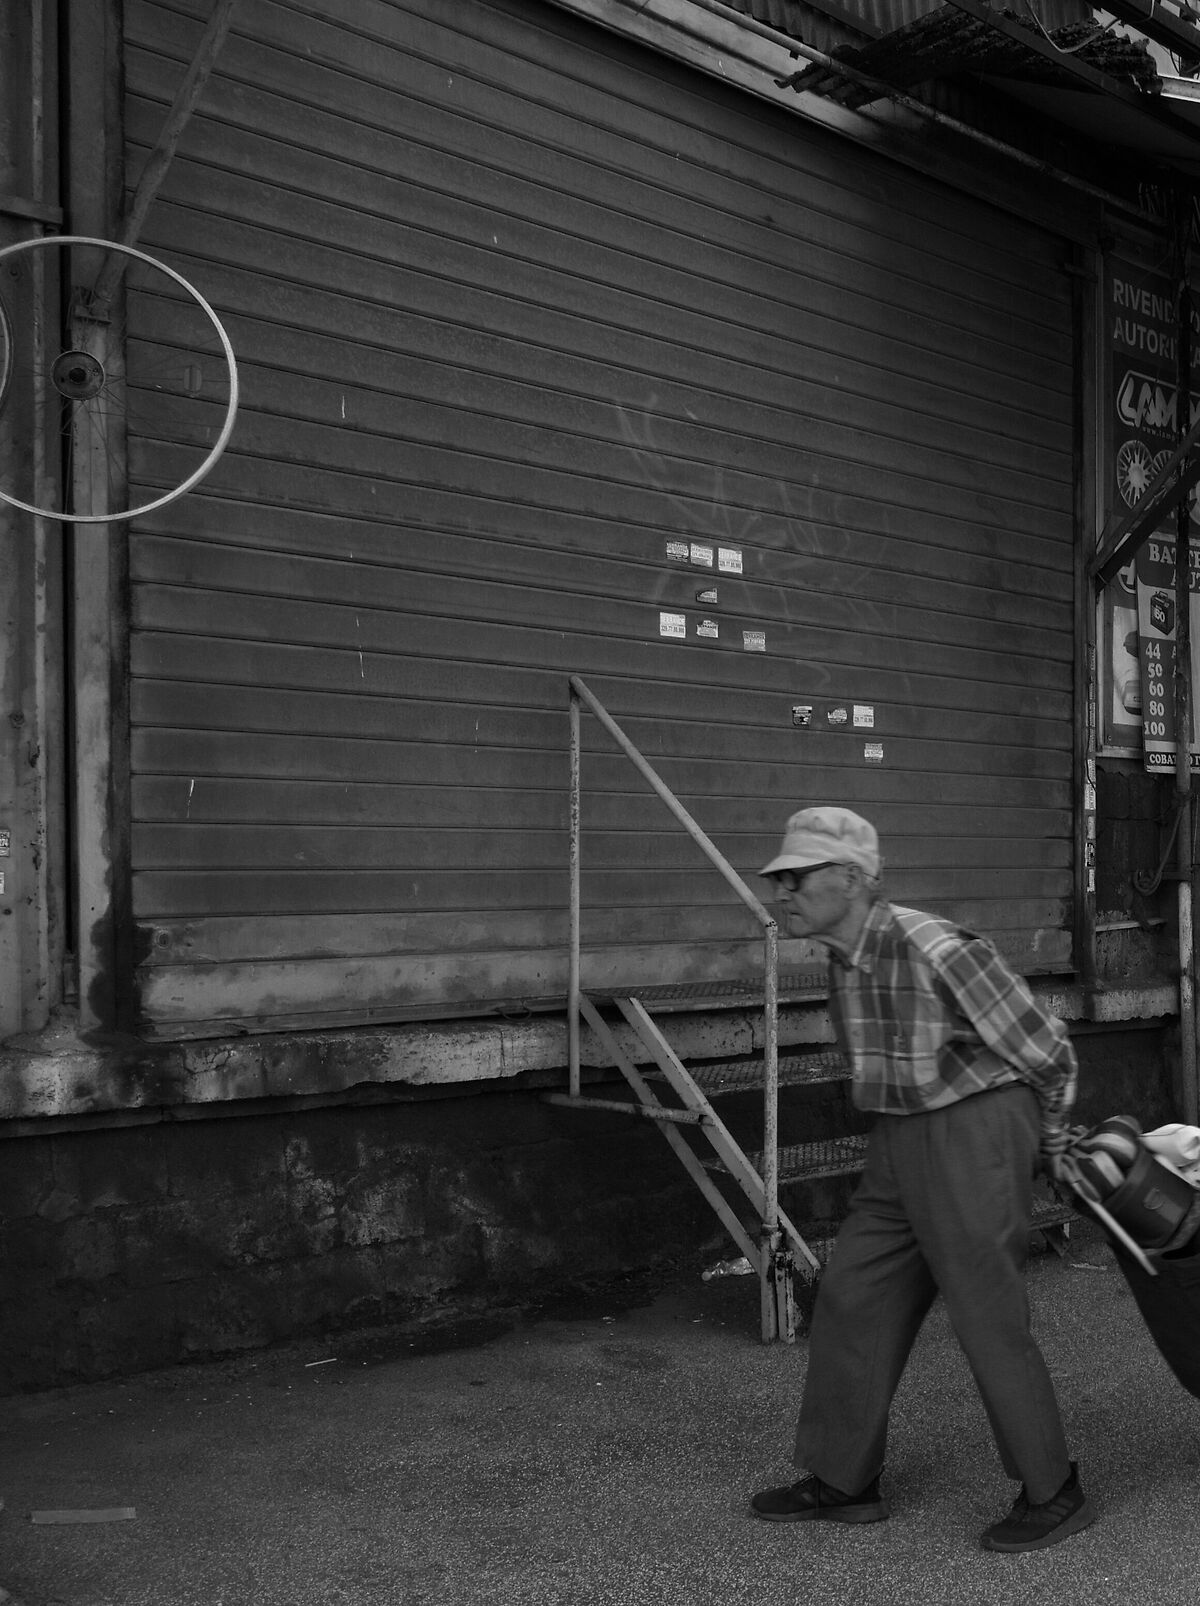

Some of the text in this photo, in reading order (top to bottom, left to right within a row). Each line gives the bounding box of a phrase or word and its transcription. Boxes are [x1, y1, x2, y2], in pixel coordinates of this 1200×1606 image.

[1145, 641, 1161, 659] 44
[1147, 663, 1163, 678] 50
[1149, 681, 1164, 697] 60
[1149, 700, 1165, 716] 80
[1144, 722, 1165, 736] 100
